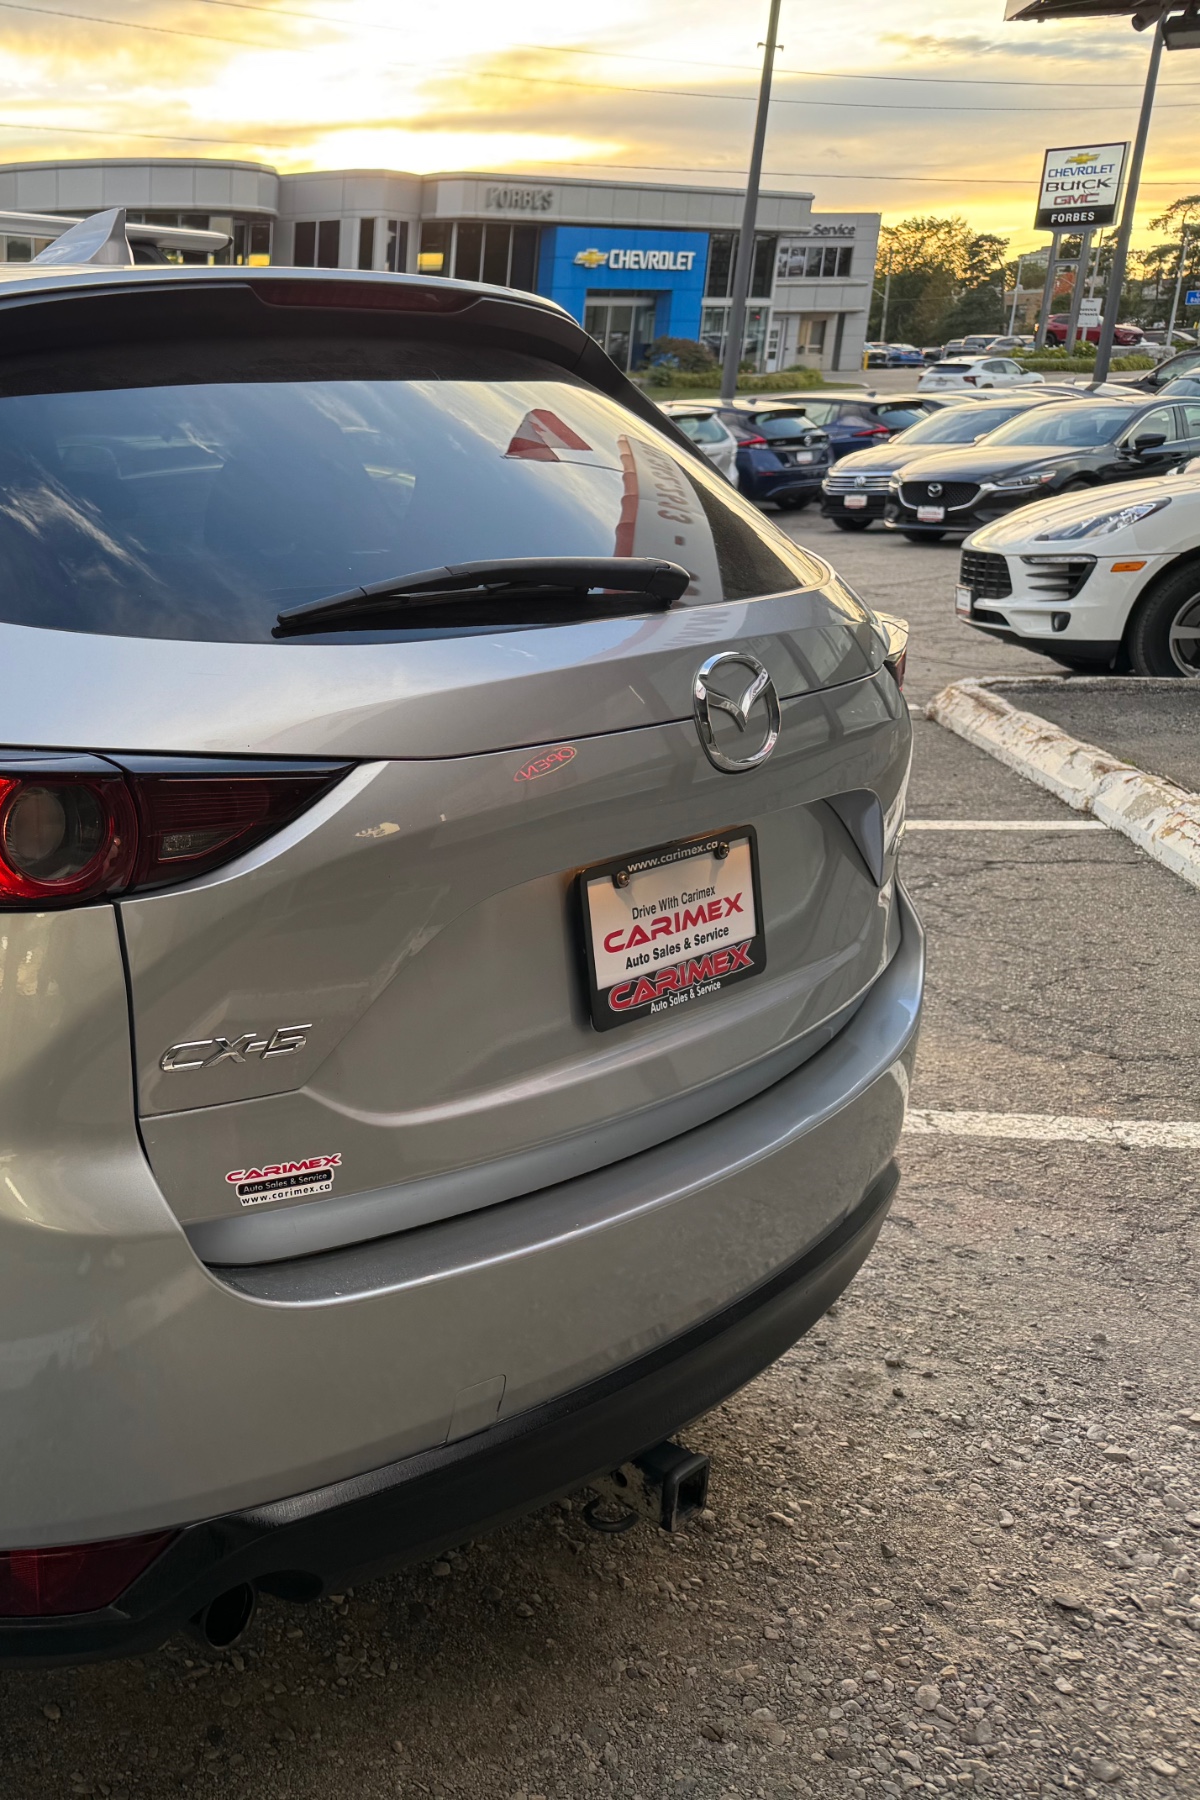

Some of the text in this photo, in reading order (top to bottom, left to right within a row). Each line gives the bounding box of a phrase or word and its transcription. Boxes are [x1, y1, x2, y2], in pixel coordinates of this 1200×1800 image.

[1047, 163, 1116, 178] CHEVROLET
[1045, 177, 1113, 193] BUICK
[486, 186, 553, 211] FORBES
[1053, 192, 1100, 206] GMC
[813, 223, 856, 236] Service
[1050, 211, 1095, 224] FORBES
[608, 248, 696, 272] CHEVROLET
[627, 840, 718, 872] www.carimex.ca
[632, 885, 716, 920] Drive With Carimex
[603, 892, 744, 953] CARIMEX
[625, 925, 729, 970] Auto Sales & Service
[609, 940, 754, 1011] CARIMEX
[650, 980, 721, 1014] Auto Sales & Service
[160, 1023, 313, 1073] CX-5
[226, 1154, 341, 1182] CARIMEX
[241, 1182, 331, 1205] www.carimex.ca
[243, 1183, 263, 1194] Auto
[265, 1179, 288, 1190] Sales
[298, 1172, 328, 1184] Service
